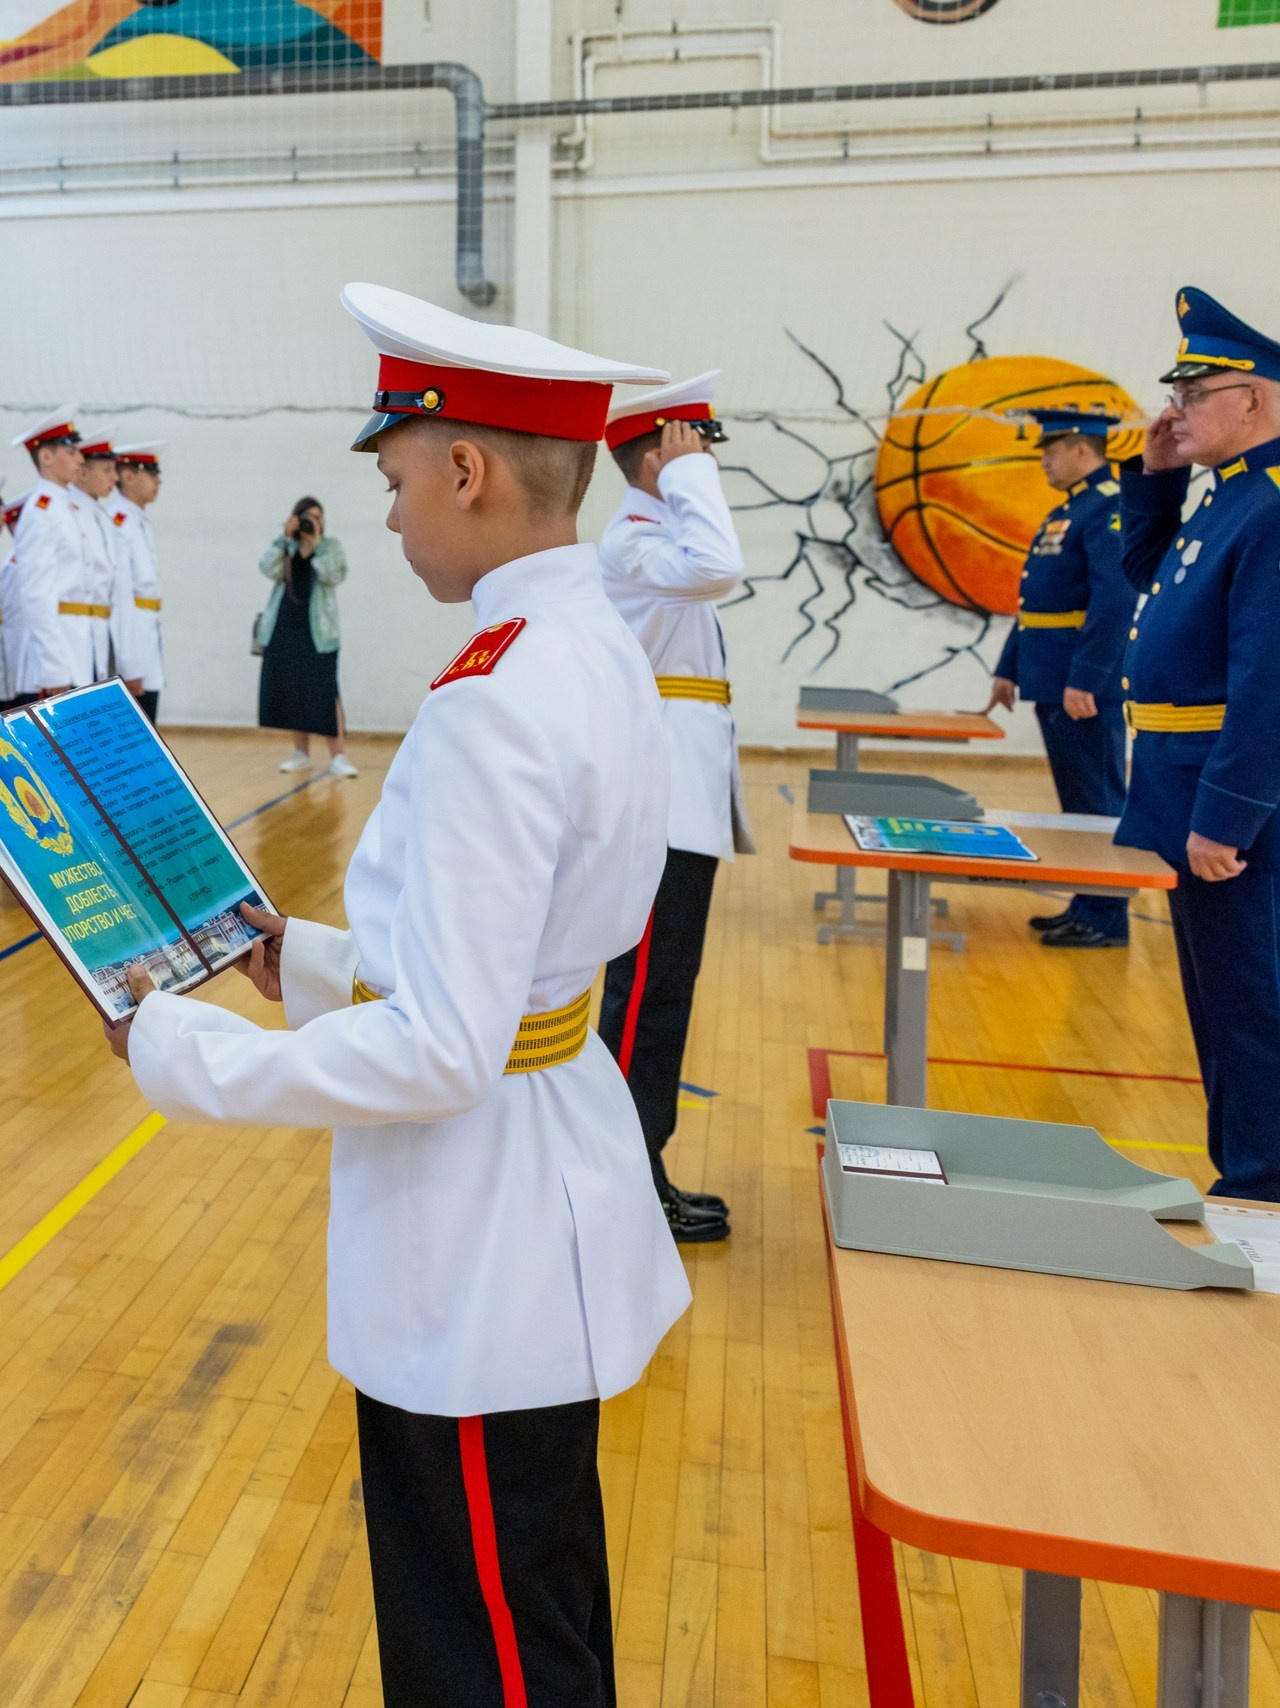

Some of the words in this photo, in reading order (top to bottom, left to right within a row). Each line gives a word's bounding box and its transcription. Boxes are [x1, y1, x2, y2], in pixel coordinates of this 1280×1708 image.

[61, 912, 115, 944] УПОРСТВО
[111, 909, 123, 924] И
[119, 904, 138, 920] ЧЕС
